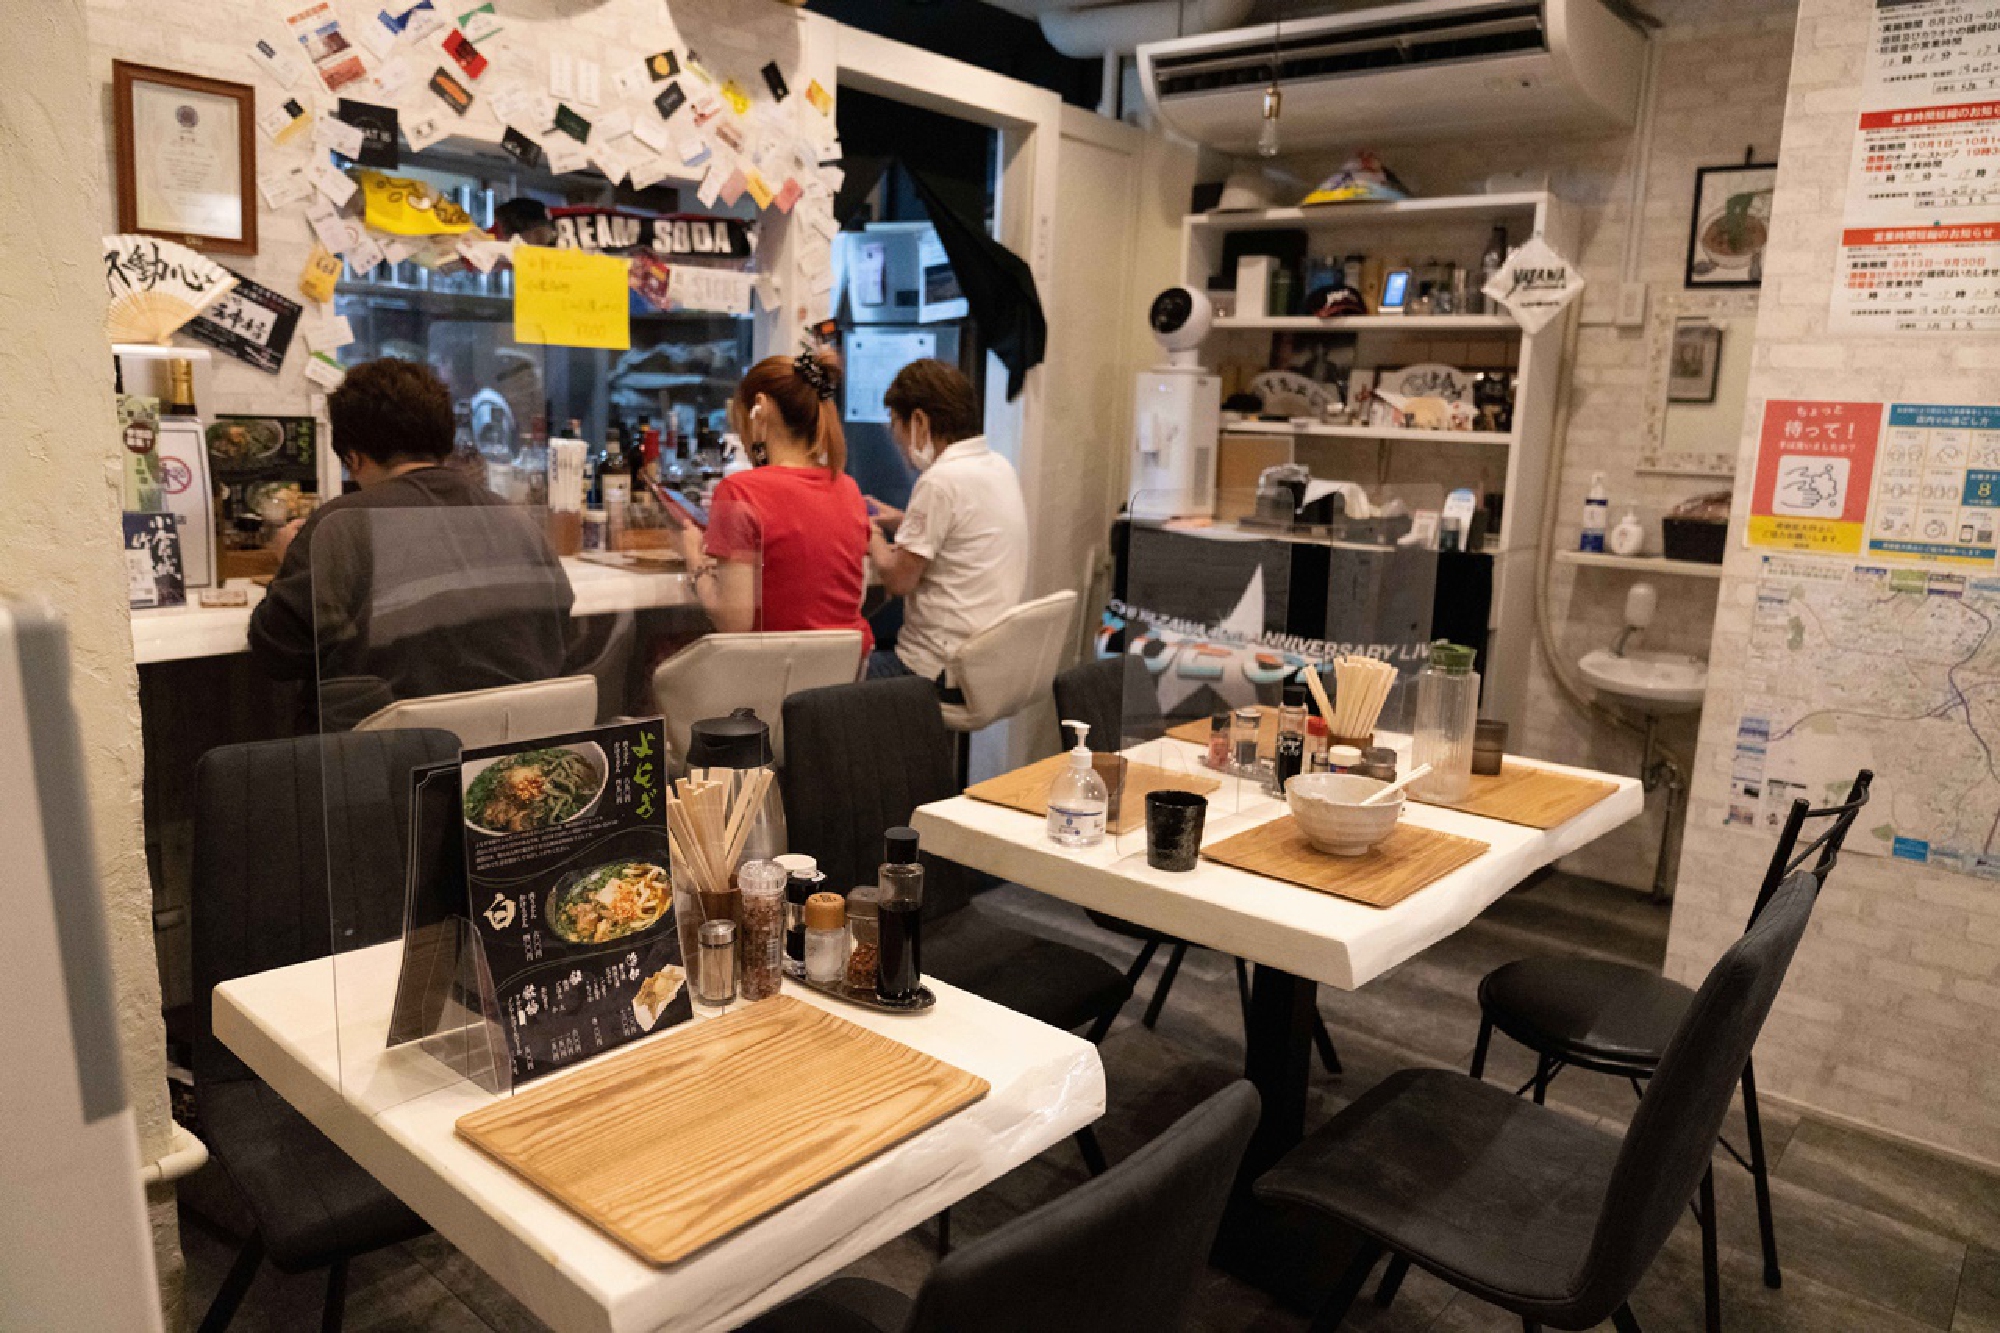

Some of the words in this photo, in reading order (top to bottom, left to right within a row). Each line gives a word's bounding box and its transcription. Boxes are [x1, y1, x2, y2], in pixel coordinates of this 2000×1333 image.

[652, 219, 732, 254] SODA
[1796, 405, 1843, 417] ちょっと
[1978, 482, 1991, 498] 8
[1398, 642, 1432, 661] LIV
